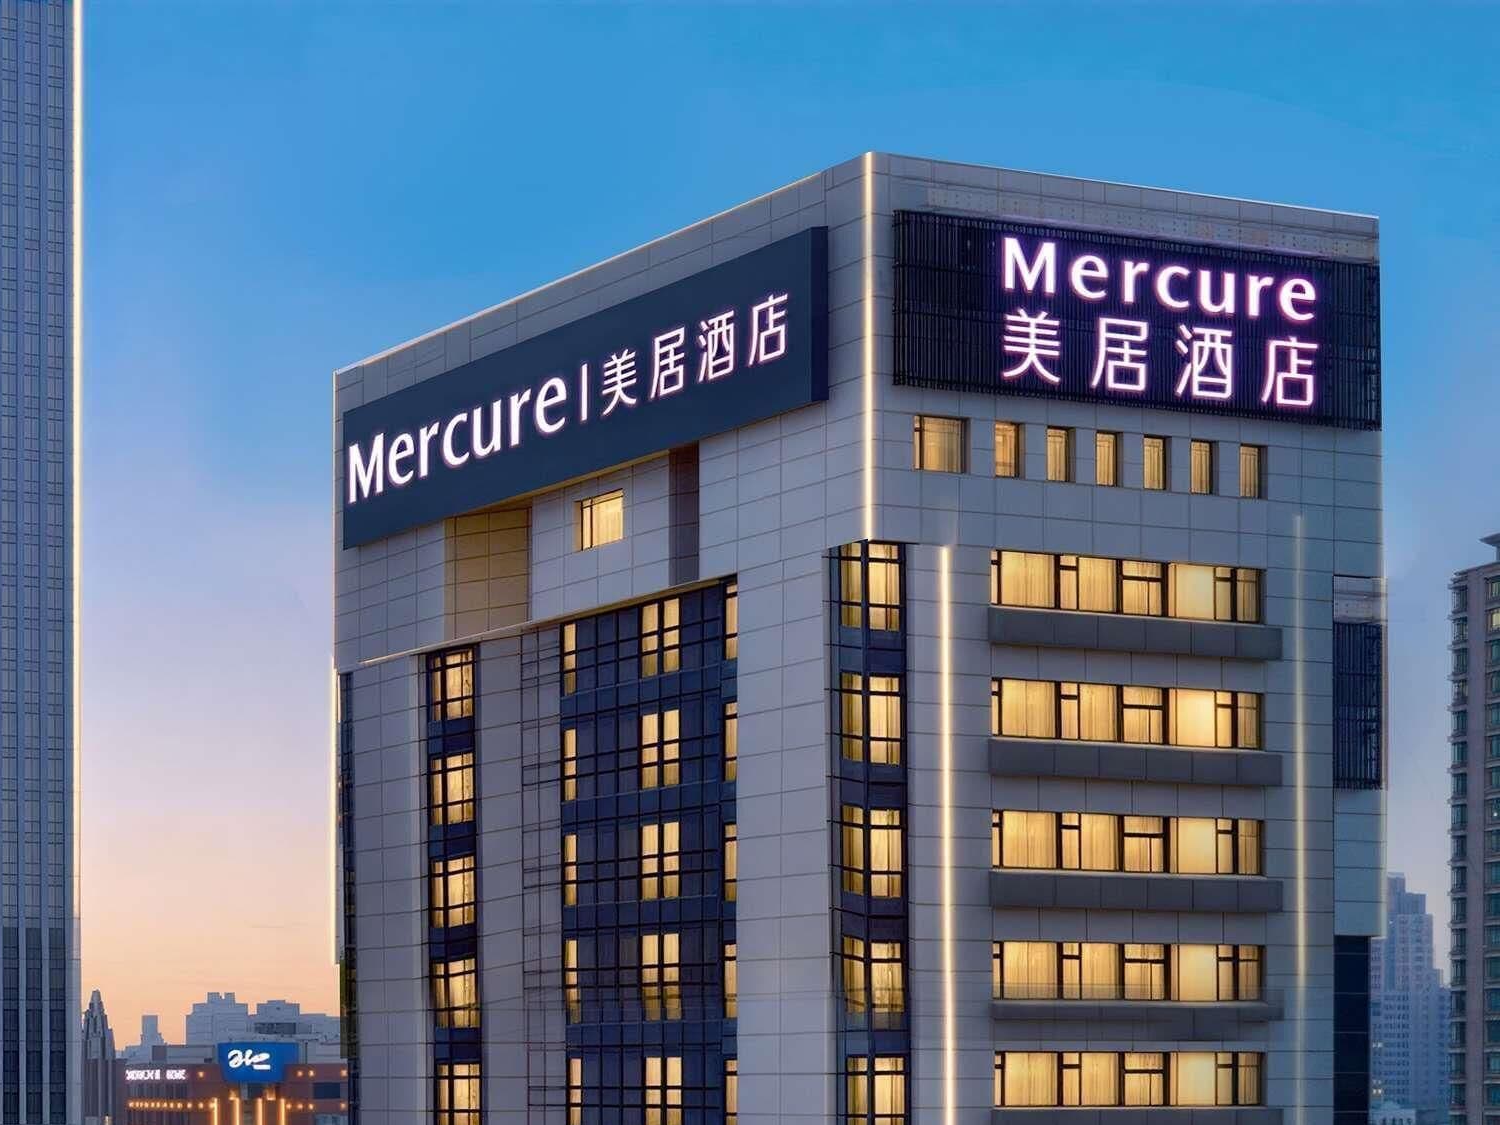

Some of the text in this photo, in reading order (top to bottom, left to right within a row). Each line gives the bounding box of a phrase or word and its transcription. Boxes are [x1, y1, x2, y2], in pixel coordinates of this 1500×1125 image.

[1003, 237, 1317, 322] Mercure
[349, 293, 788, 504] Mercure 美居酒店
[1003, 309, 1318, 407] 美居酒店
